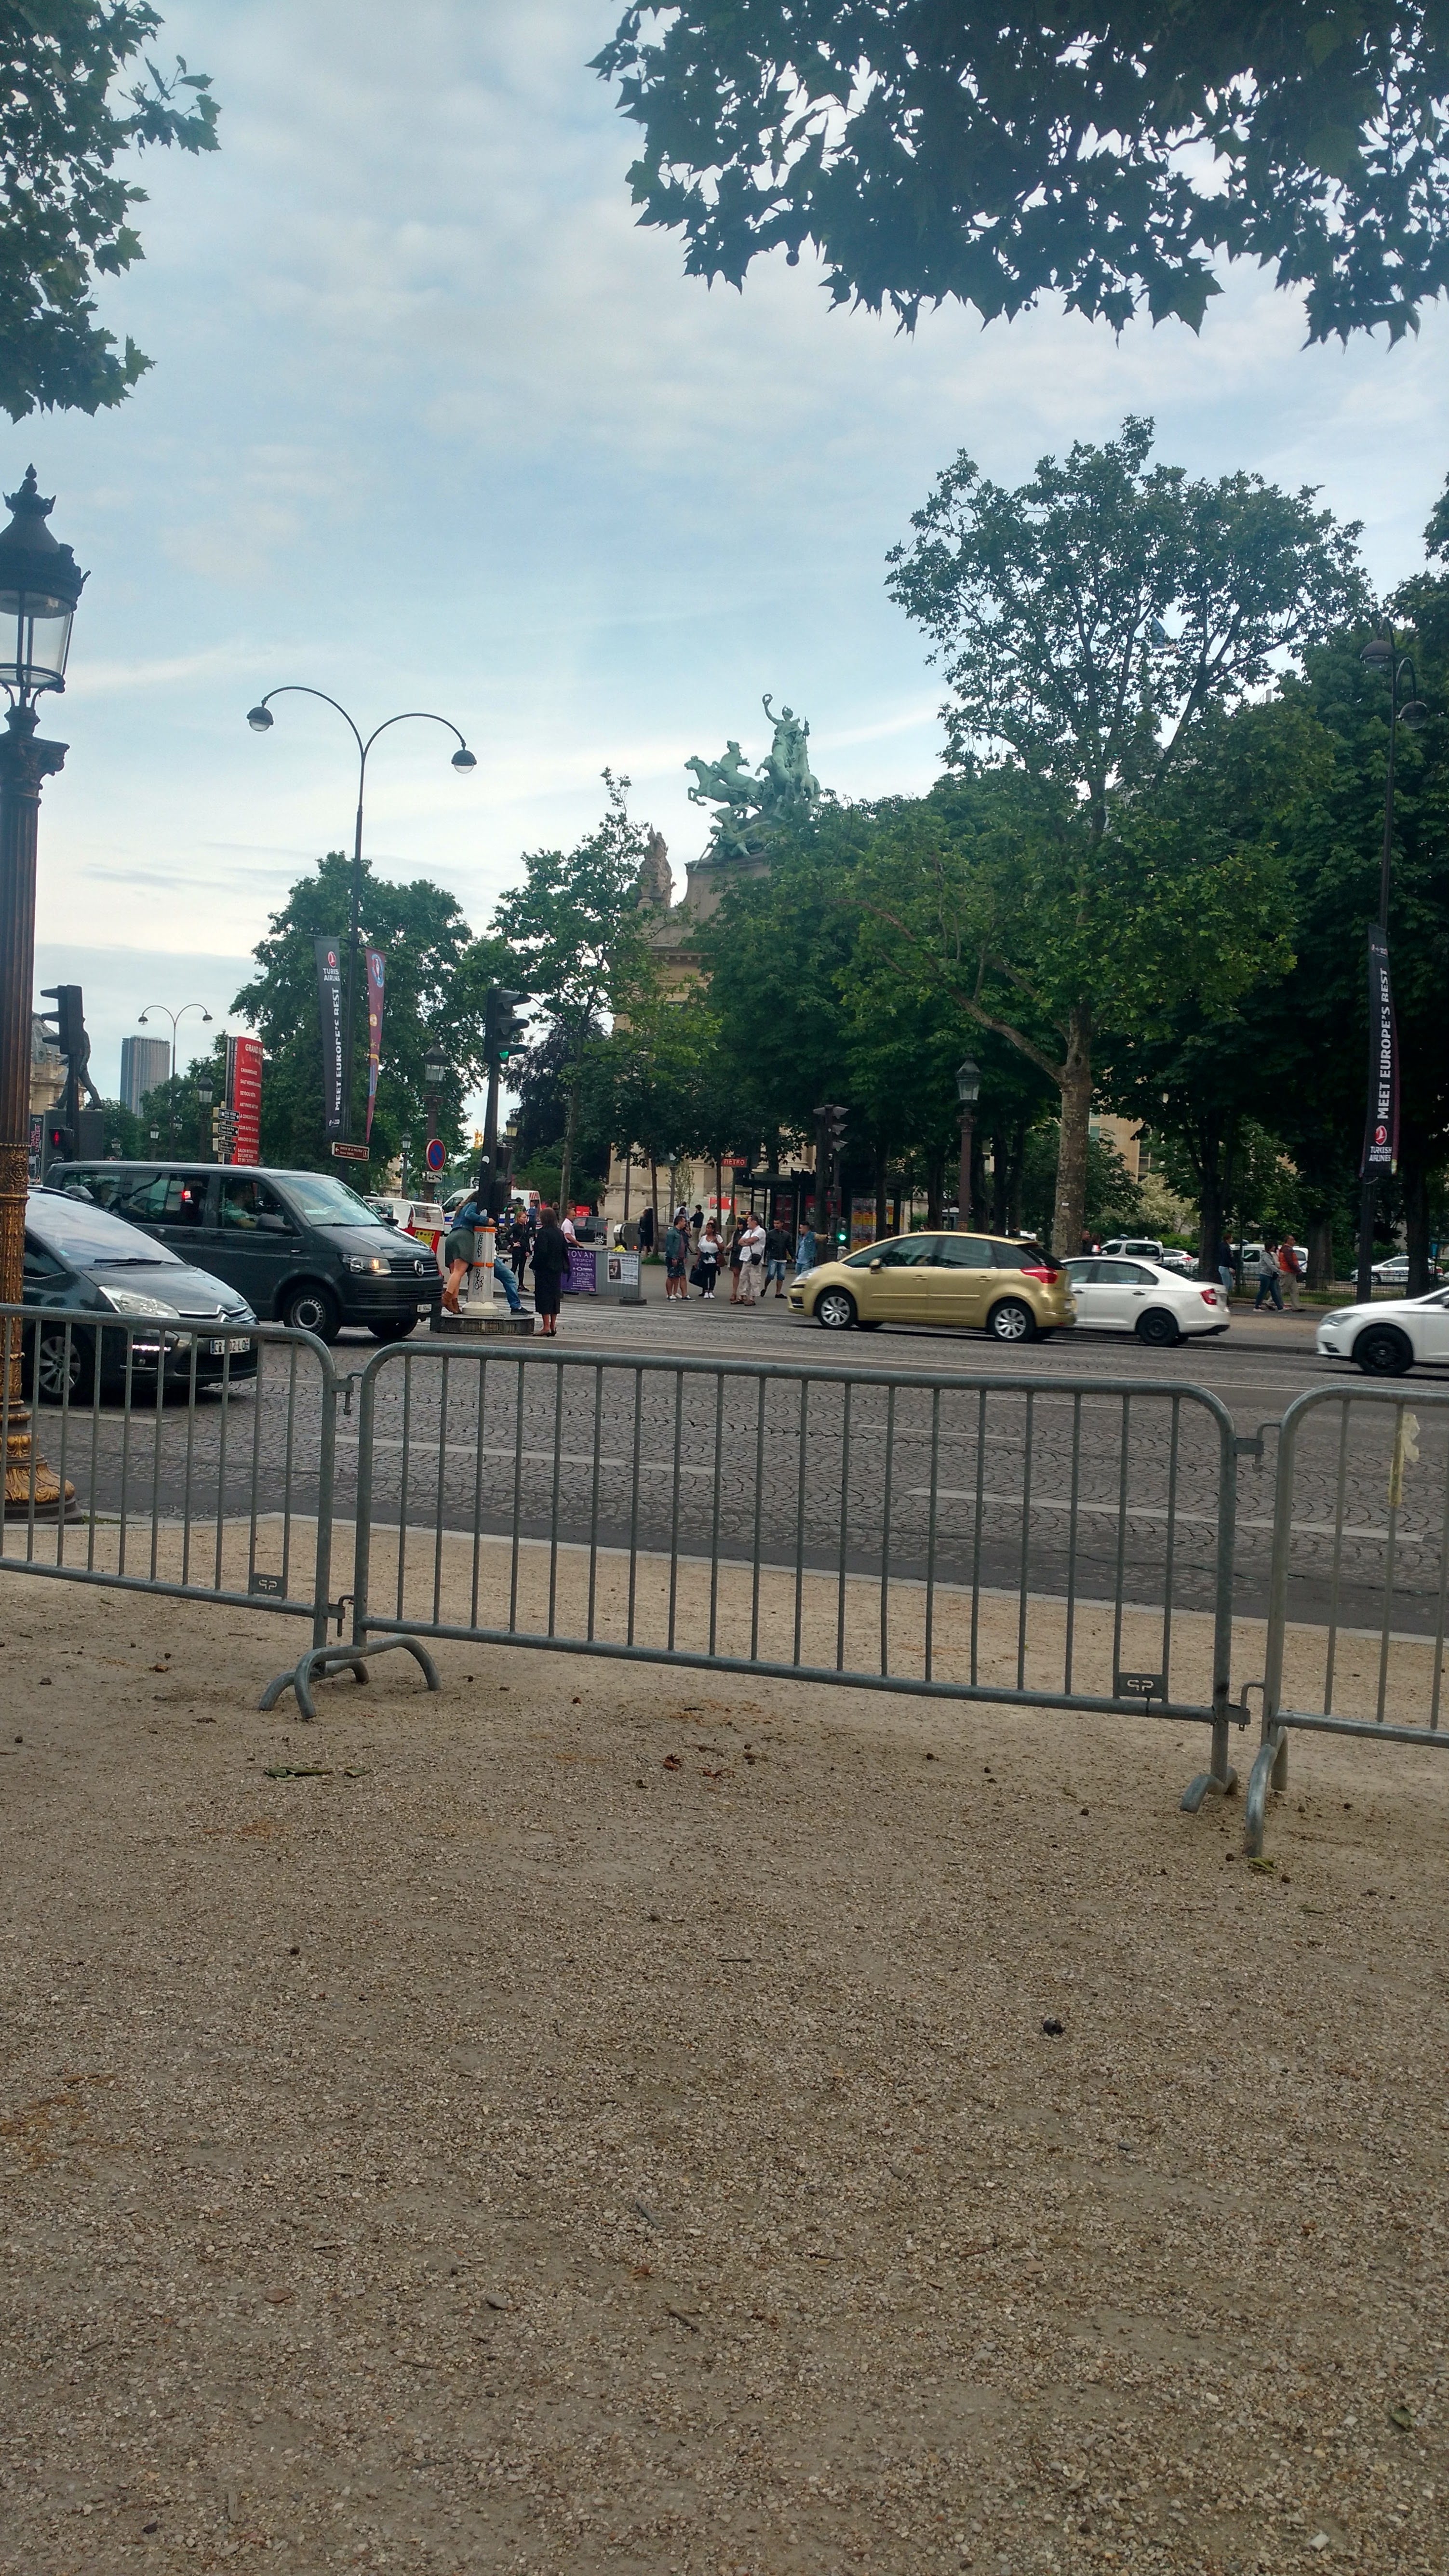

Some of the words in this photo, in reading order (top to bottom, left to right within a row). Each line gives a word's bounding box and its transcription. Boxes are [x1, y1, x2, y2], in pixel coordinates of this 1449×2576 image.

[1380, 967, 1389, 1002] BEST
[1380, 1006, 1391, 1078] EUROPE'S
[1377, 1083, 1390, 1119] MEET
[1370, 1146, 1392, 1154] TURKISH
